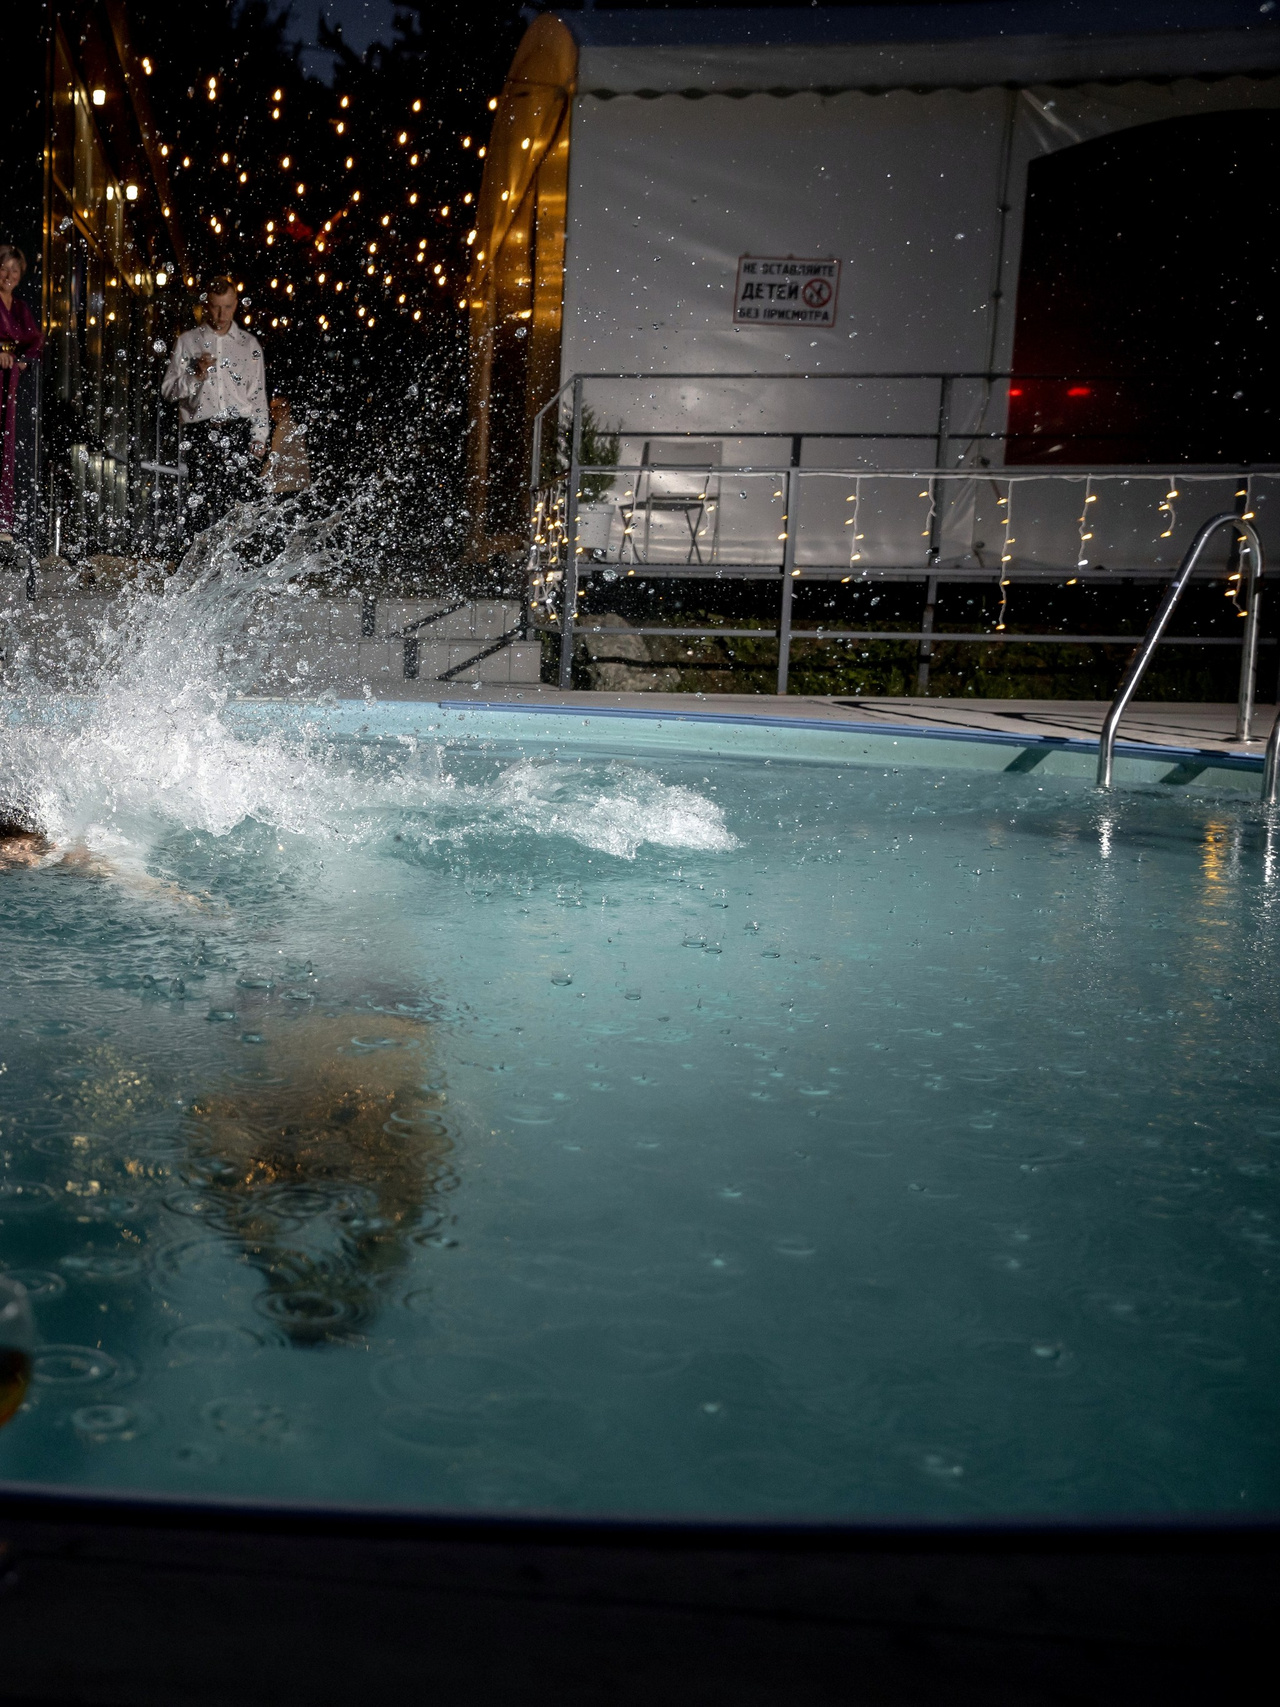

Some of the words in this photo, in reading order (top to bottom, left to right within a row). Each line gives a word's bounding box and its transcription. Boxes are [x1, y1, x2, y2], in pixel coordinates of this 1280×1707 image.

[743, 263, 757, 275] НЕ
[742, 281, 799, 300] ДЕТЕЙ
[738, 308, 759, 319] БЕЗ
[763, 308, 829, 321] ПРИСМОТРА
